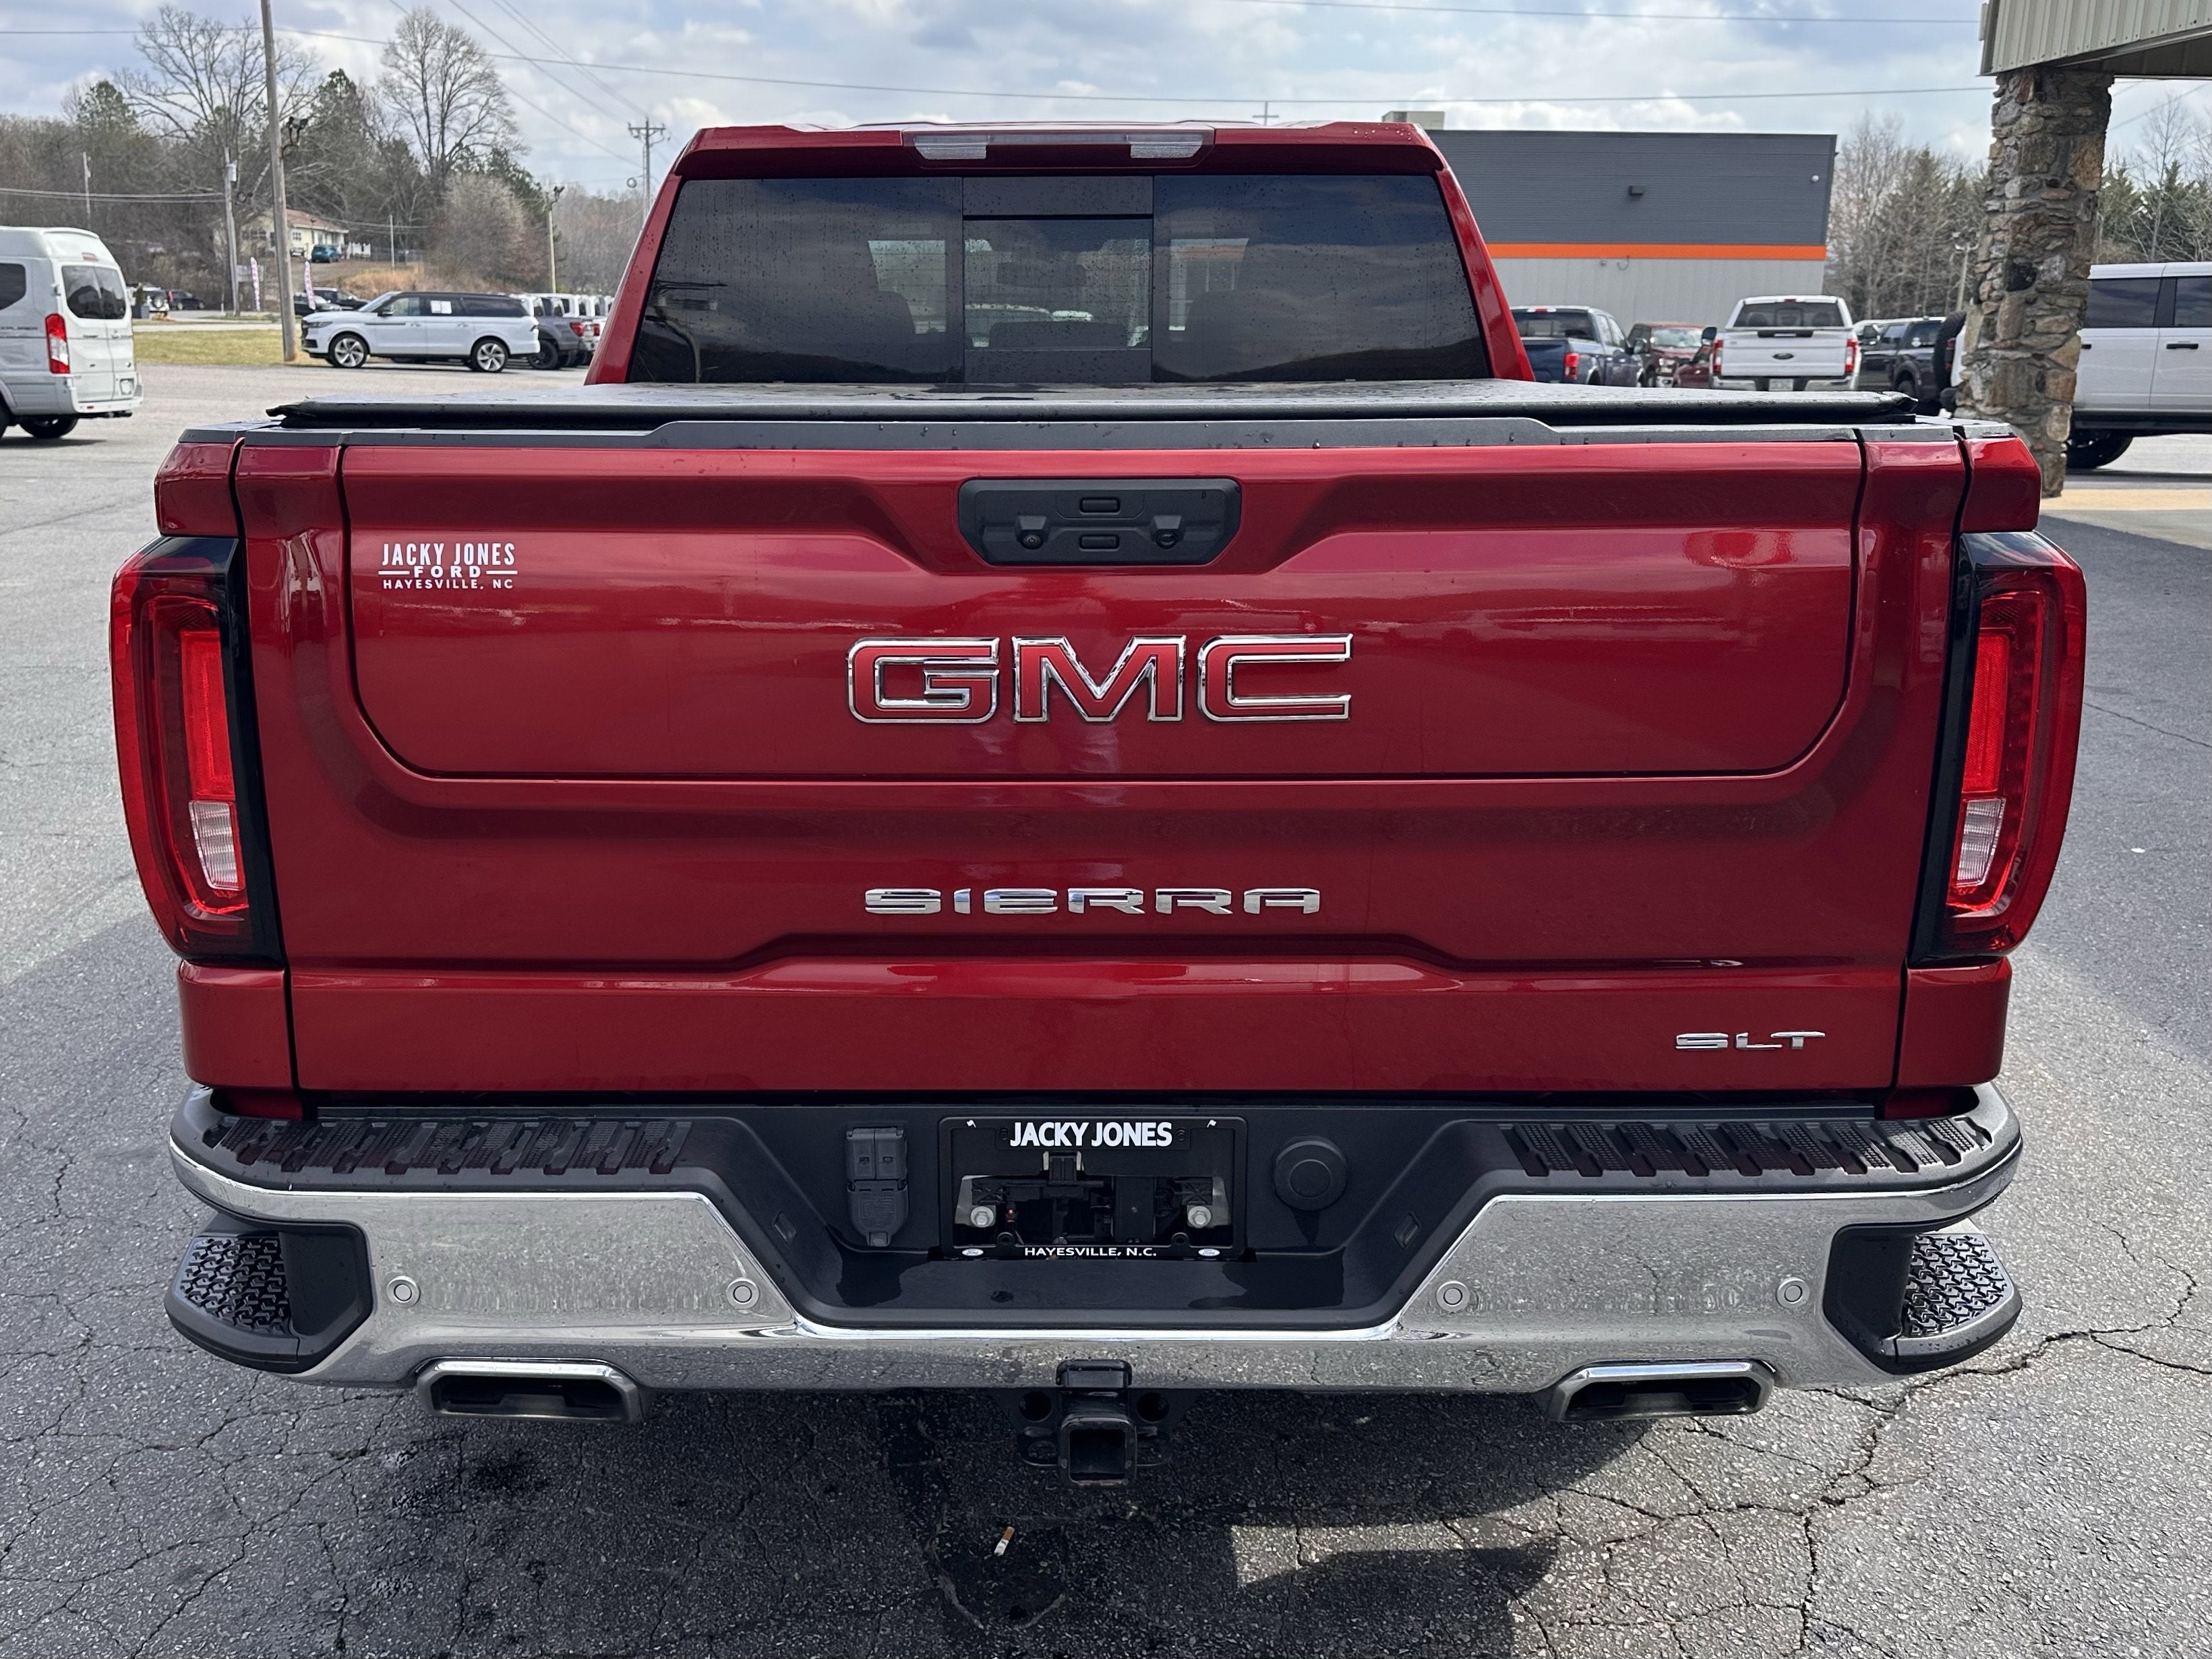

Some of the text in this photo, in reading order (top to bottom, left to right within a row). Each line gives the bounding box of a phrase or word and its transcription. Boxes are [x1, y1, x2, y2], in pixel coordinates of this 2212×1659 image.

[382, 543, 515, 566] JACKY JONES
[413, 566, 481, 578] FORD
[383, 579, 513, 590] HAYESVILLE, NC
[847, 633, 1352, 725] GMC
[865, 888, 1320, 915] SIERRA
[1675, 1031, 1826, 1050] SLT
[1010, 1122, 1172, 1147] JACKY JONES
[1025, 1247, 1157, 1257] HAYESVILLE, N.C.
